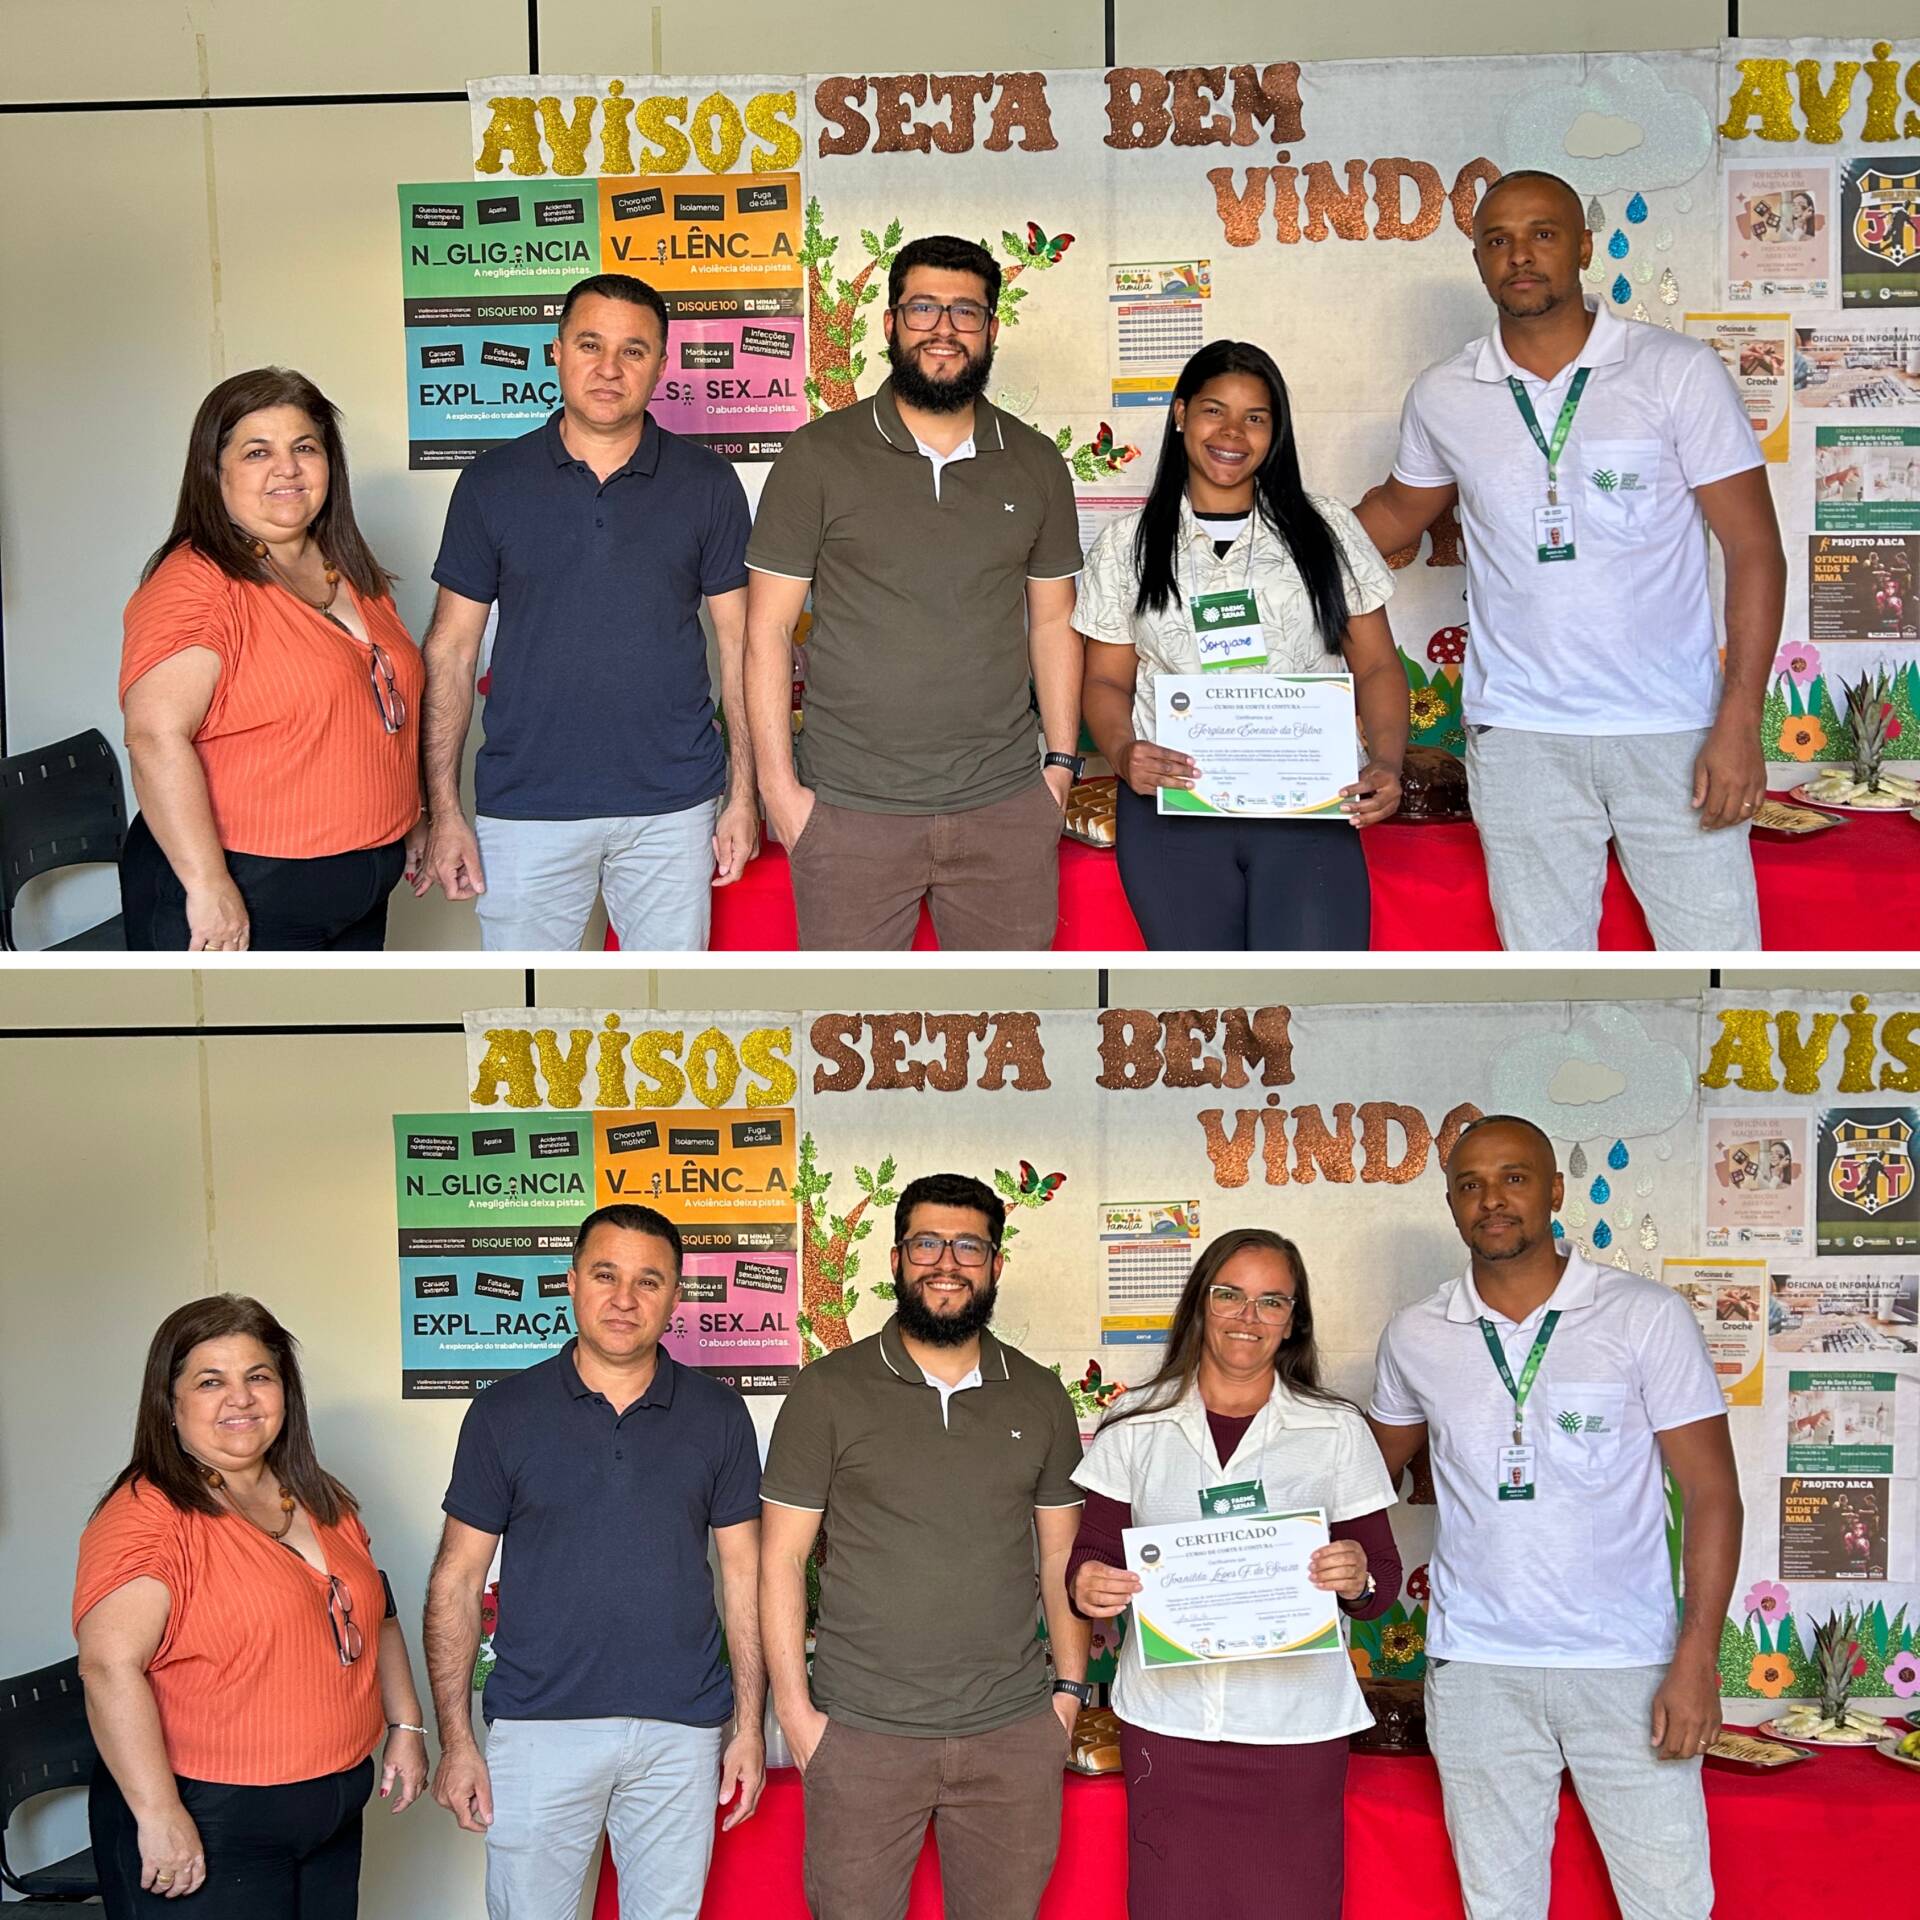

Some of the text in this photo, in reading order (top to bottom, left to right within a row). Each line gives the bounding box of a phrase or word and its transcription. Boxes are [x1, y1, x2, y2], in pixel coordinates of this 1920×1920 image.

[1718, 41, 1920, 144] AVI
[814, 61, 1306, 158] SEJA BEM
[618, 195, 657, 207] Choro sem
[753, 191, 772, 201] Fuga
[626, 203, 651, 213] motivo
[680, 203, 720, 212] Isolamento
[473, 265, 593, 279] A negligência deixa pistas.
[690, 265, 698, 274] A
[698, 263, 738, 273] violência
[738, 263, 764, 273] deixa
[751, 329, 786, 341] Infecções
[1851, 334, 1865, 342] DE
[745, 337, 790, 349] sexualmente
[742, 344, 790, 357] transmissíveis
[706, 404, 799, 416] O abuso deixa pistas.
[1831, 538, 1906, 548] PROJETO ARCA
[1813, 555, 1859, 564] OFICINA
[1813, 564, 1841, 573] KIDS
[1813, 573, 1843, 582] MMA
[1205, 687, 1306, 699] CERTIFICADO
[809, 1005, 1296, 1094] SEJA BEM
[613, 1128, 652, 1141] Choro sem
[747, 1126, 766, 1136] Fuga
[621, 1137, 647, 1146] motivo
[674, 1137, 715, 1147] Isolamento
[468, 1198, 588, 1210] A negligência deixa pistas.
[684, 1199, 693, 1207] A
[692, 1198, 732, 1208] violência
[732, 1198, 757, 1207] deixa
[744, 1263, 780, 1275] Infecções
[738, 1271, 783, 1283] sexualmente
[735, 1277, 784, 1291] transmissíveis
[1787, 1279, 1901, 1289] OFICINA DE INFORMÁTICA
[445, 1342, 484, 1351] exploração
[494, 1341, 524, 1349] trabalho
[699, 1337, 790, 1348] O abuso deixa pistas.
[1802, 1480, 1874, 1490] PROJETO ARCA
[1785, 1497, 1829, 1505] OFICINA
[1785, 1506, 1811, 1514] KIDS
[1785, 1515, 1813, 1523] MMA
[1175, 1526, 1277, 1548] CERTIFICADO
